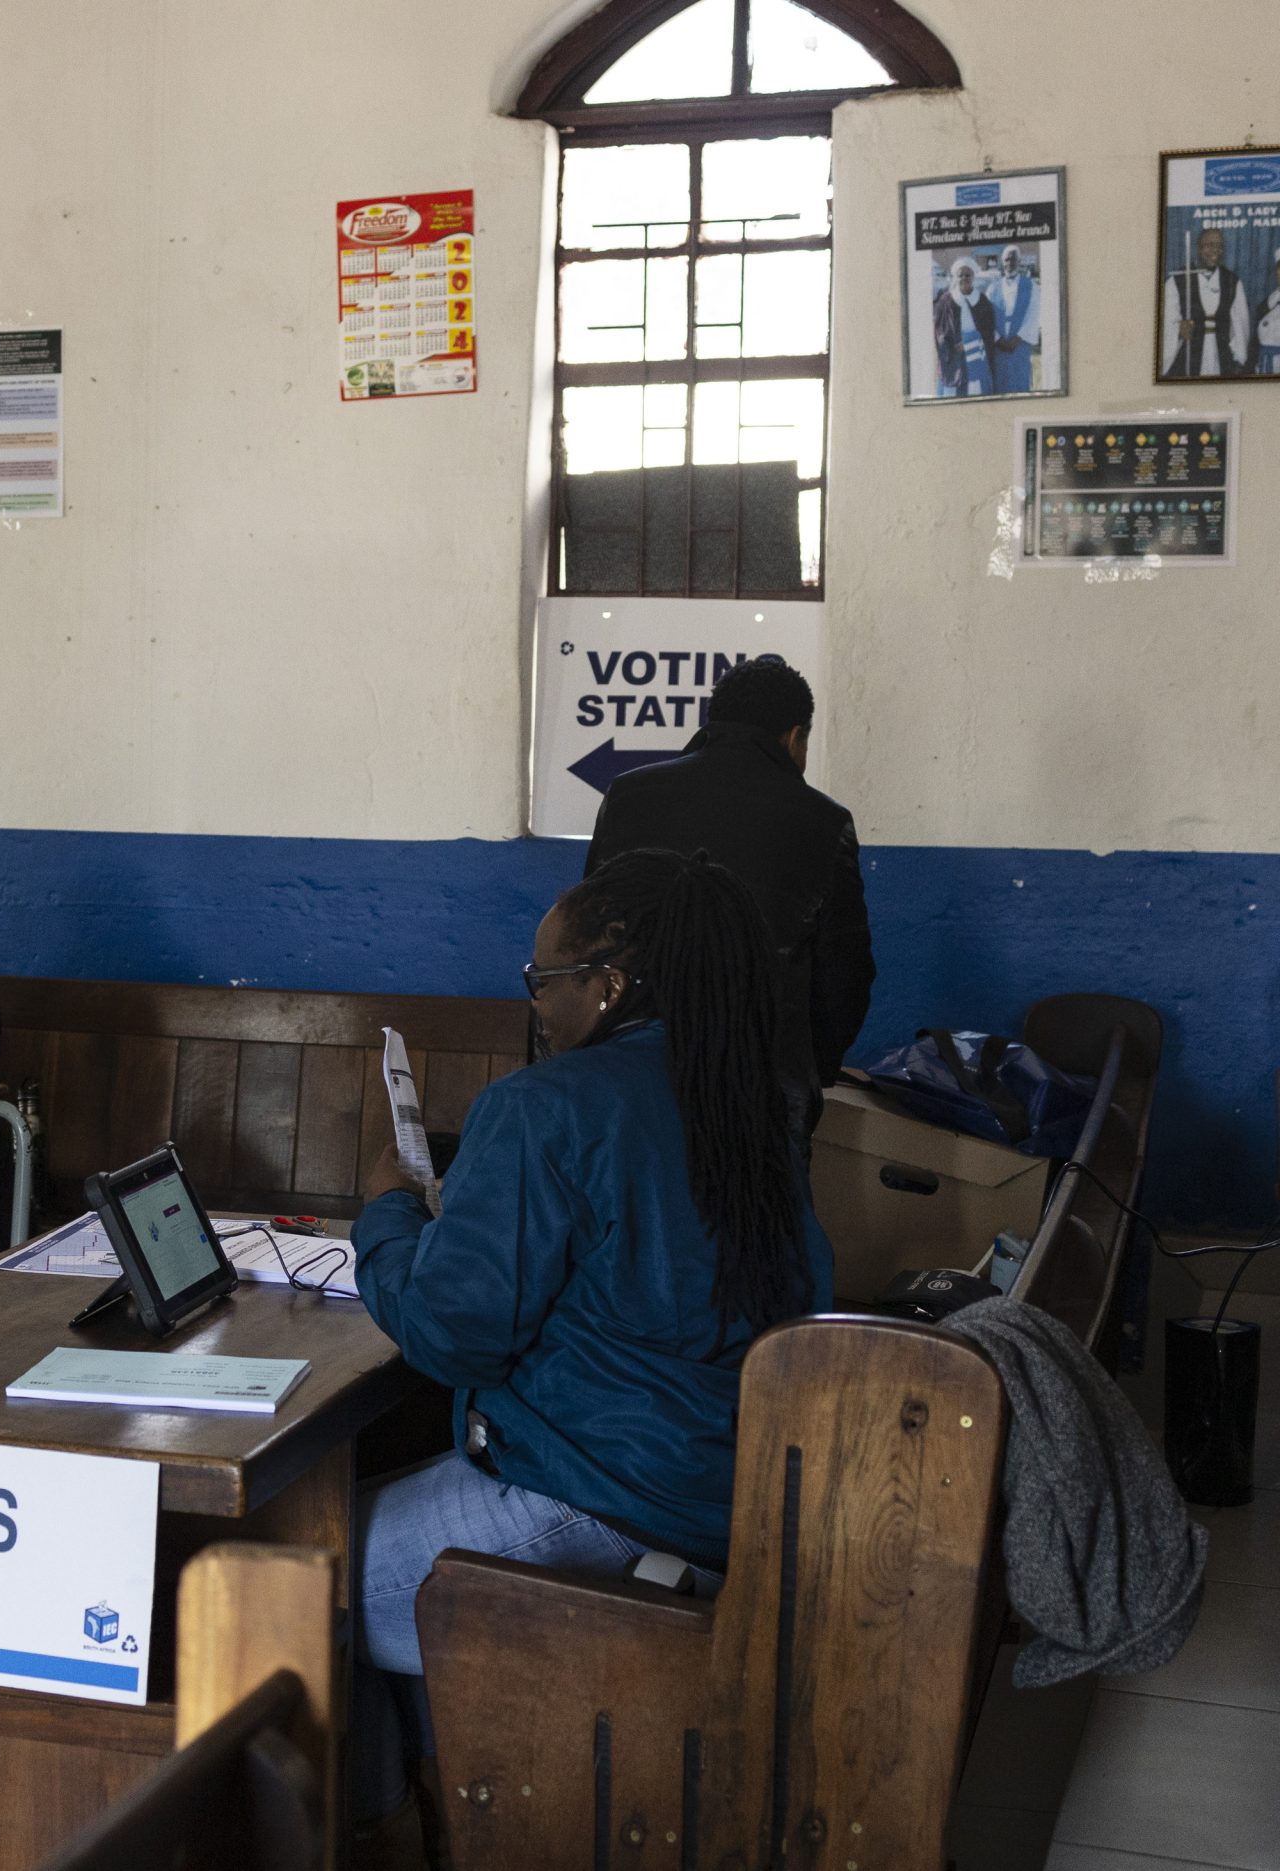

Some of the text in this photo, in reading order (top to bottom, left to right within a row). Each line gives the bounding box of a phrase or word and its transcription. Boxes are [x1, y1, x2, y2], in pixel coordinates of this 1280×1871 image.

[1247, 206, 1278, 216] LADY
[350, 209, 408, 235] Freedom
[1016, 223, 1050, 236] branch
[1203, 217, 1280, 229] BISHOP MAS
[587, 650, 785, 686] VOTIN
[576, 694, 710, 727] STATI
